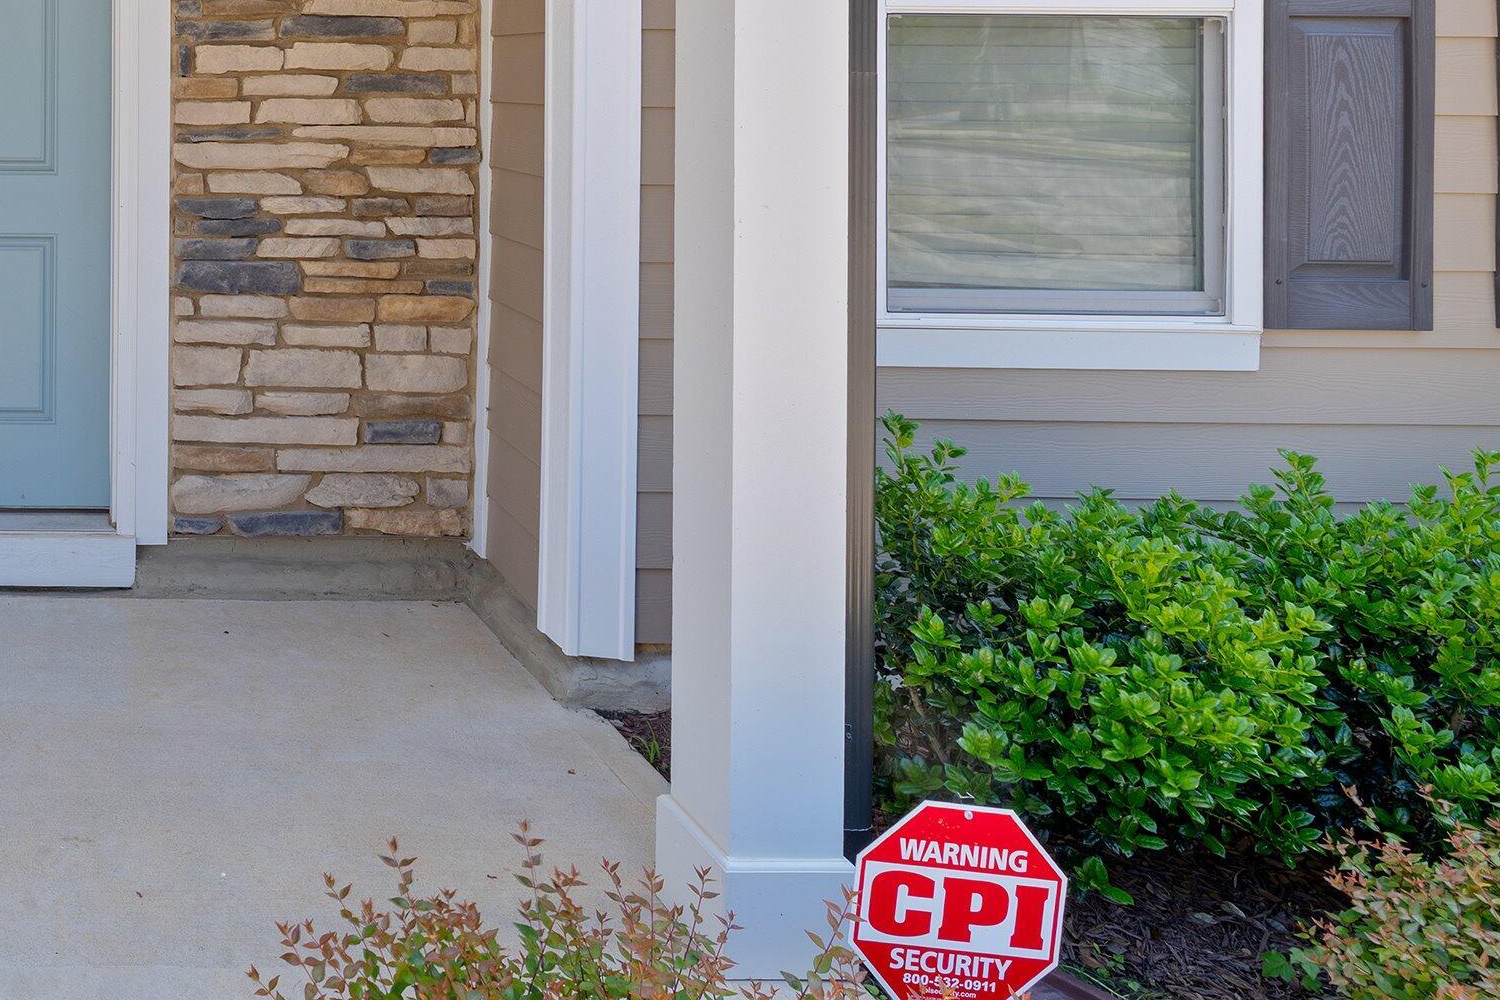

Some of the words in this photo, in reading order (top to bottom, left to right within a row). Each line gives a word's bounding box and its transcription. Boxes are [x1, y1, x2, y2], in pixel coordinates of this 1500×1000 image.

[899, 837, 1029, 873] WARNING
[867, 870, 1050, 951] CPI
[889, 947, 1012, 981] SECURITY
[902, 972, 996, 993] 800-532-0911
